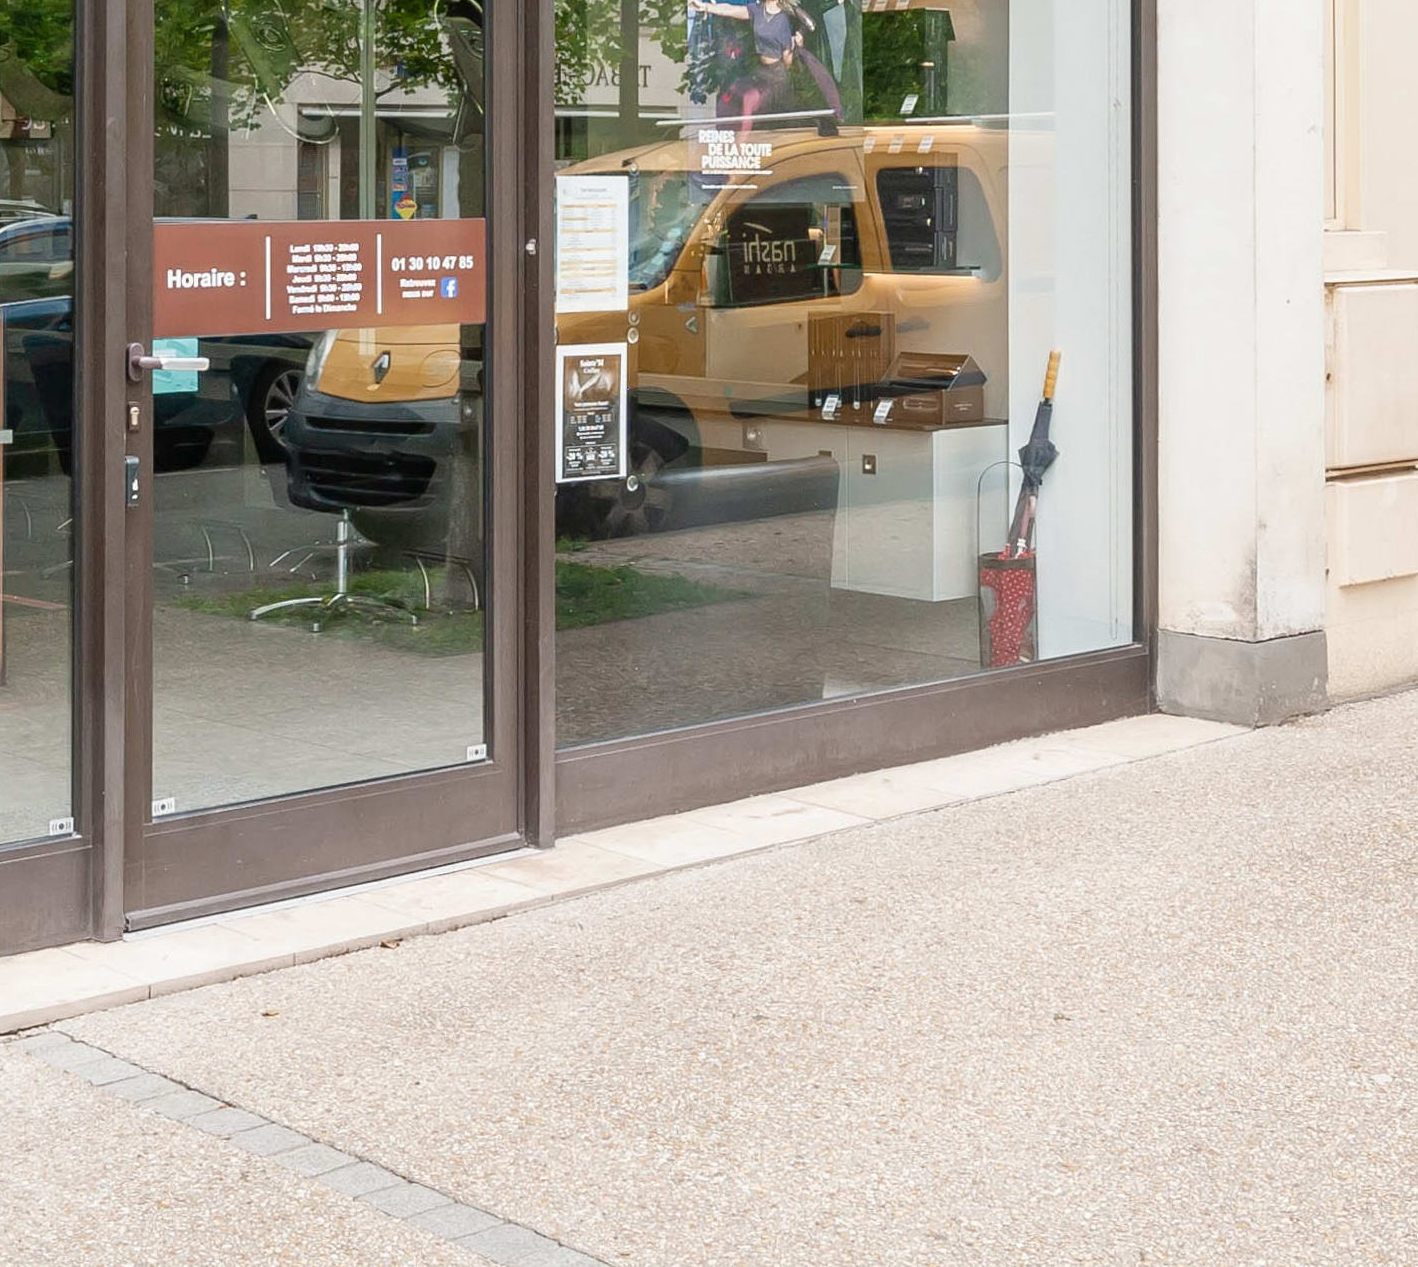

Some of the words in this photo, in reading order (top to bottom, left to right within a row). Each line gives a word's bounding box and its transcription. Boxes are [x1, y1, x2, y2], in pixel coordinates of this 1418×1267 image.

[698, 130, 734, 144] REINES
[708, 144, 723, 156] DE
[725, 144, 739, 156] LA
[739, 143, 772, 157] TOUTE
[701, 155, 761, 169] PUISSANCE
[391, 257, 405, 271] 01
[408, 257, 424, 270] 30
[426, 256, 440, 270] 10
[442, 255, 457, 269] 47
[459, 255, 473, 269] 85
[167, 268, 235, 288] Horaire
